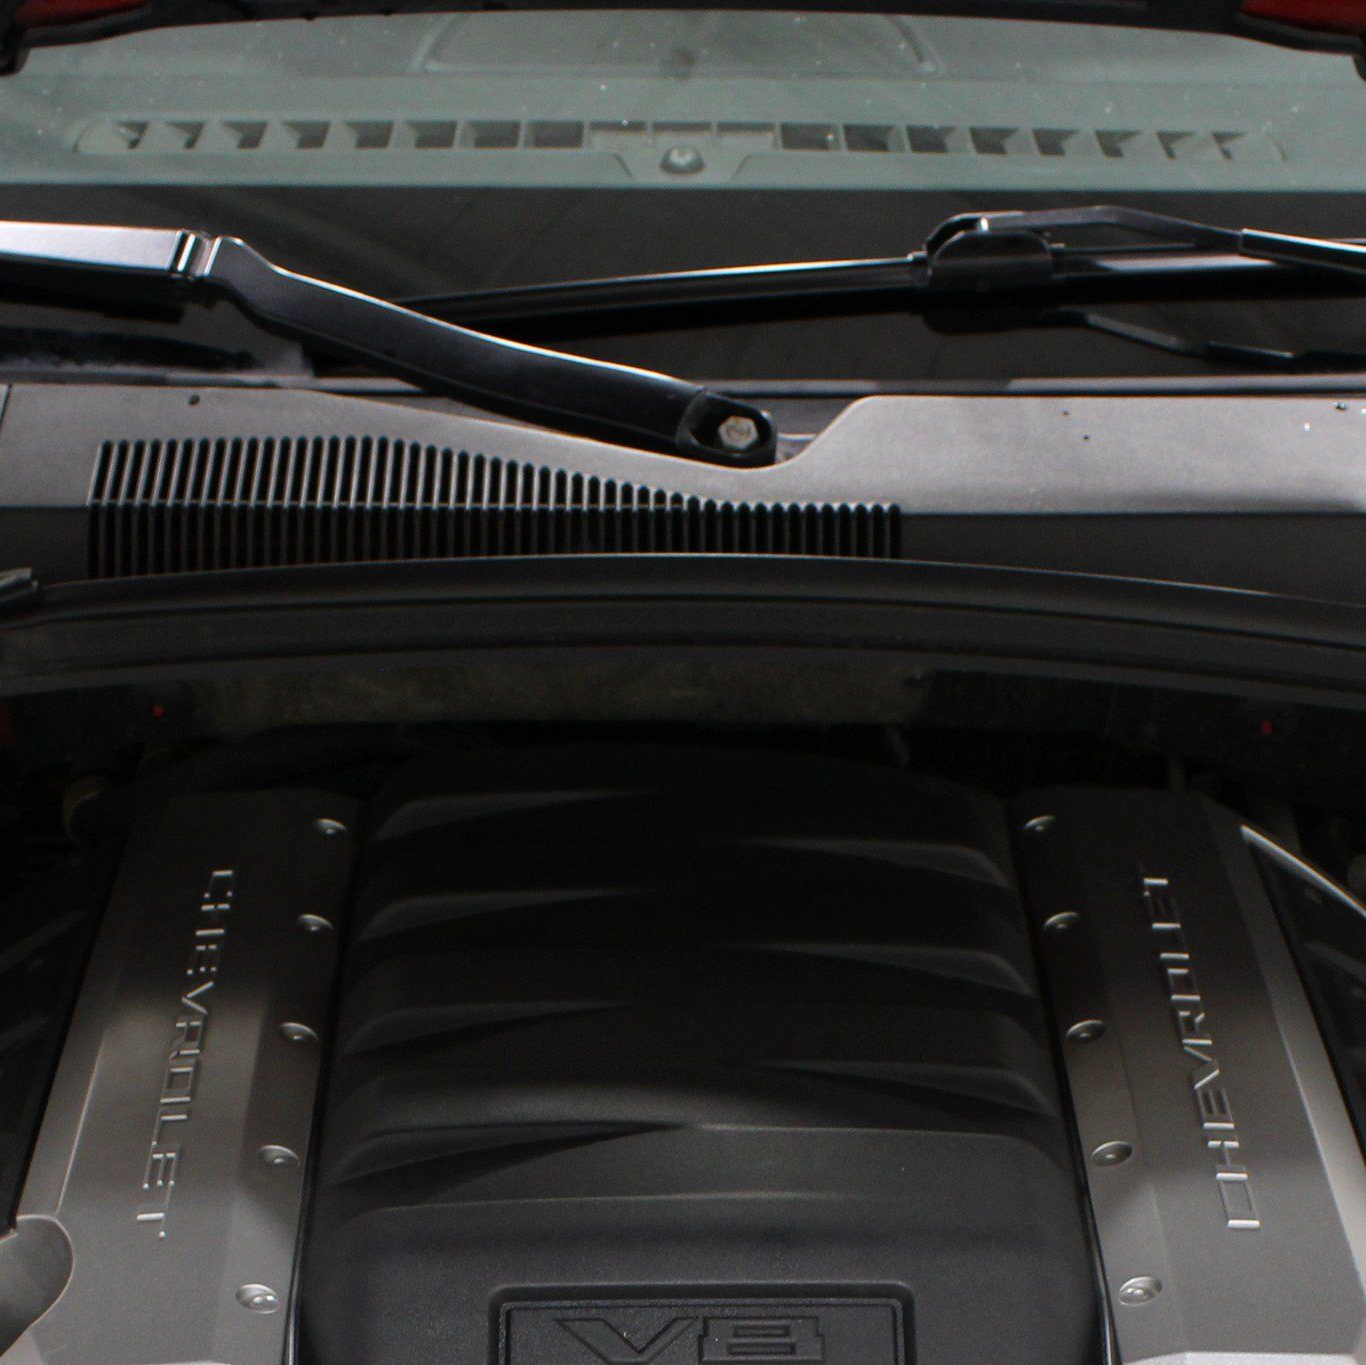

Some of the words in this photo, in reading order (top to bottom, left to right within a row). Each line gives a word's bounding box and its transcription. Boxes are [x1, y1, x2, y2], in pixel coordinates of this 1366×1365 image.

[136, 867, 234, 1239] CHEVROLET
[1140, 864, 1261, 1230] CHEVROLET
[553, 1315, 825, 1365] V8
